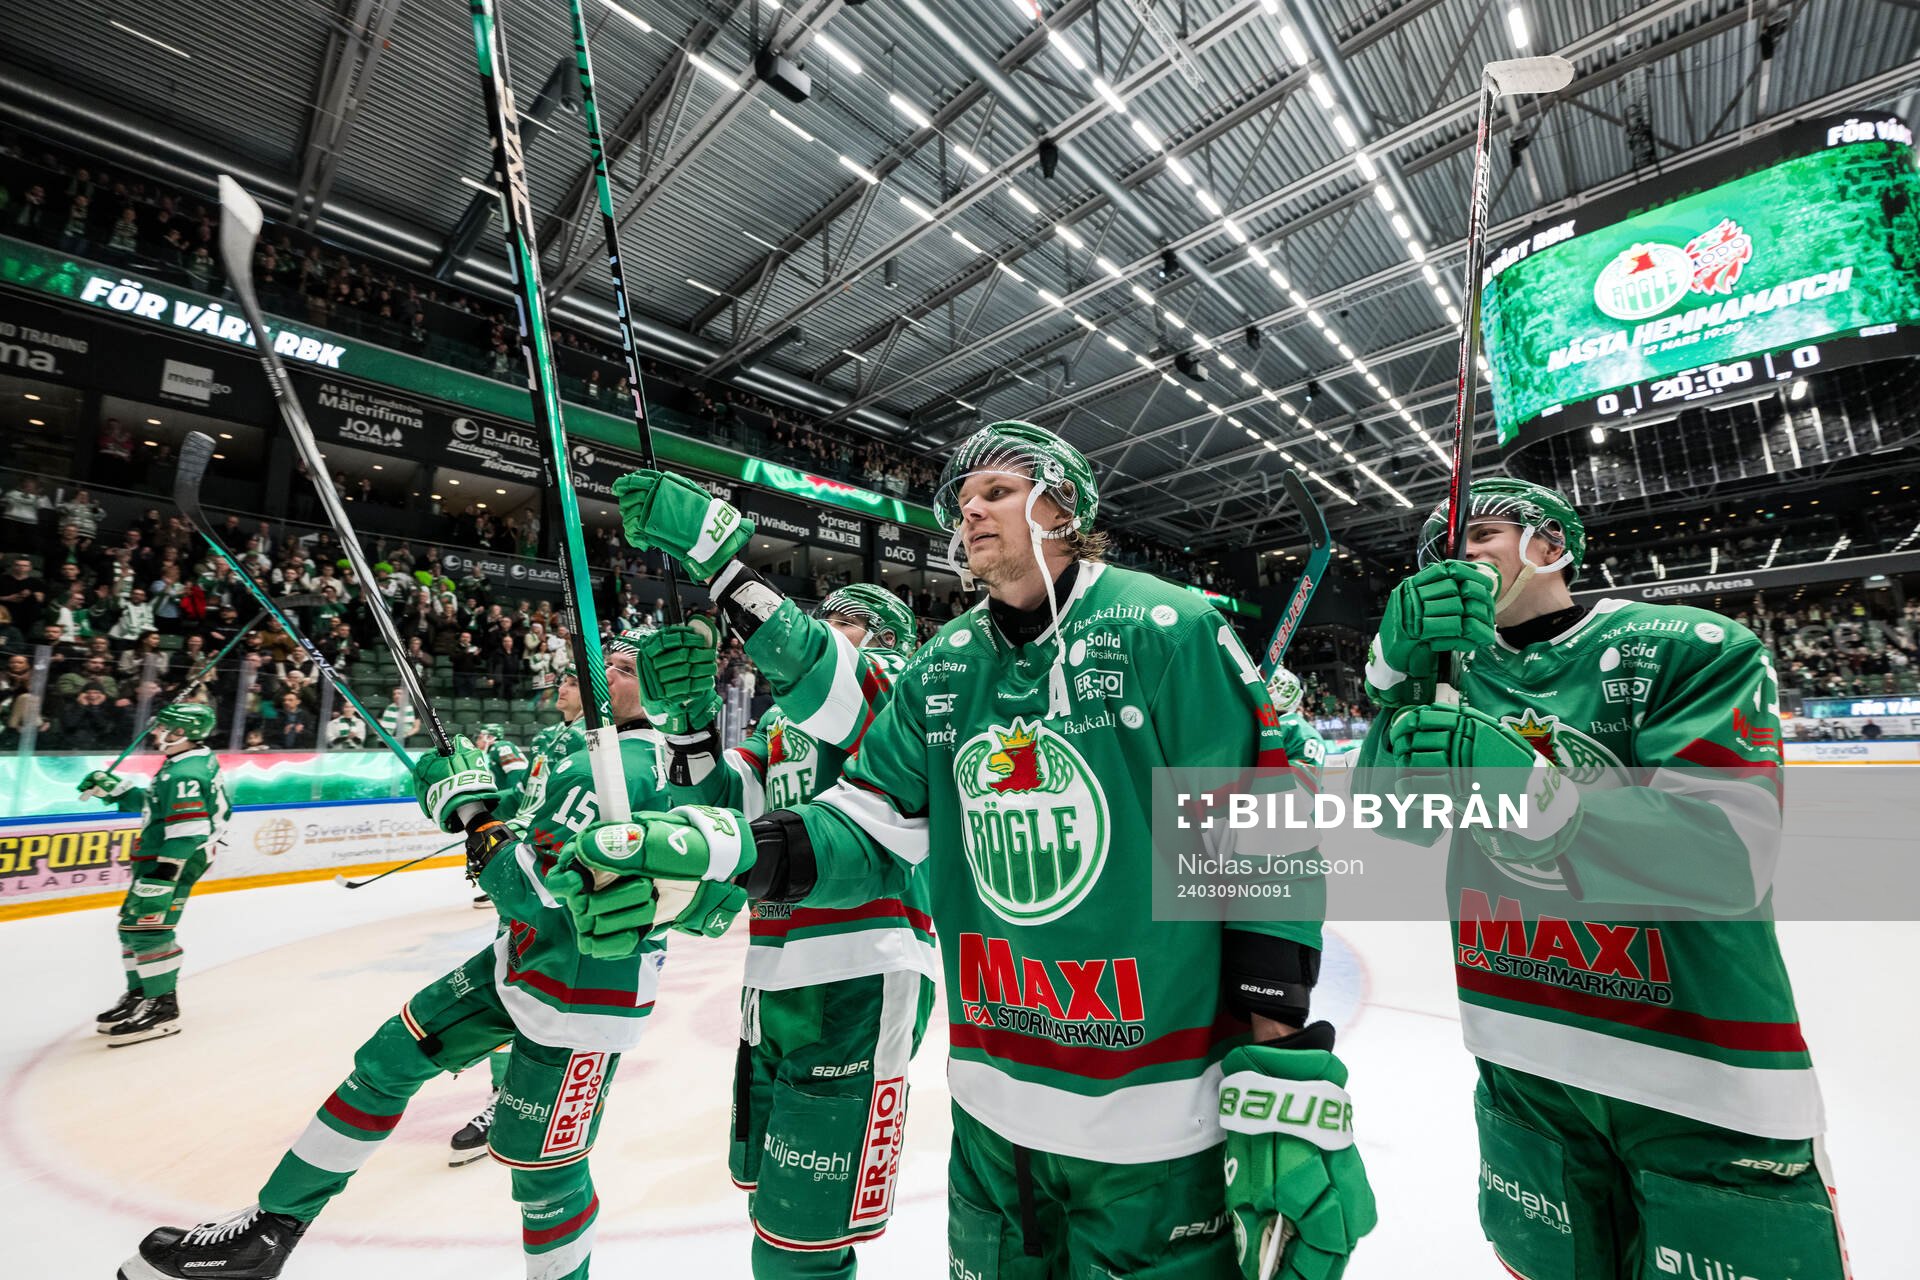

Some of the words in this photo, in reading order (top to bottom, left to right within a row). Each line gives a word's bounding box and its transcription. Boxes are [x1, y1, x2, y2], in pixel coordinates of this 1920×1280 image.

[80, 277, 169, 321] FÖR
[173, 302, 271, 349] VÅRT
[273, 330, 347, 369] RBK
[1547, 330, 1629, 373] NÄSTA
[1632, 267, 1853, 349] HEMMAMATCH
[1792, 345, 1821, 369] 0
[1650, 361, 1754, 403] 20:00
[1596, 393, 1620, 415] 0
[339, 417, 383, 439] JOA
[482, 426, 541, 452] BJÄR
[760, 515, 810, 537] Wihlborgs
[884, 546, 915, 562] DACO
[1642, 582, 1701, 599] CATENA
[1704, 577, 1754, 593] Arena
[1073, 604, 1146, 635] Backahill
[1269, 574, 1314, 665] BAUER
[1086, 632, 1121, 649] Solid
[176, 780, 201, 799] 12
[552, 785, 601, 834] 15
[967, 800, 1082, 868] RÖGLE
[0, 828, 141, 876] SPORT
[1458, 887, 1672, 984] MAXI
[960, 932, 1145, 1022] MAXI
[1457, 945, 1492, 971] ICA
[1494, 955, 1674, 1006] STORMARKNAD
[1240, 983, 1285, 998] BAUER
[963, 1002, 996, 1027] ICA
[997, 1006, 1145, 1048] STORMARKNAD
[811, 1060, 870, 1077] BAUER
[552, 1058, 596, 1146] ER-HO
[579, 1074, 602, 1121] BYGG
[1218, 1086, 1354, 1133] BAUER
[519, 1114, 548, 1123] group
[770, 1136, 851, 1173] Liljedahl
[860, 1086, 898, 1210] ER-HO
[888, 1110, 904, 1177] BYGG
[813, 1170, 849, 1182] group
[526, 1207, 565, 1220] BAUER
[1524, 1209, 1572, 1235] group
[183, 1259, 228, 1268] BAUER
